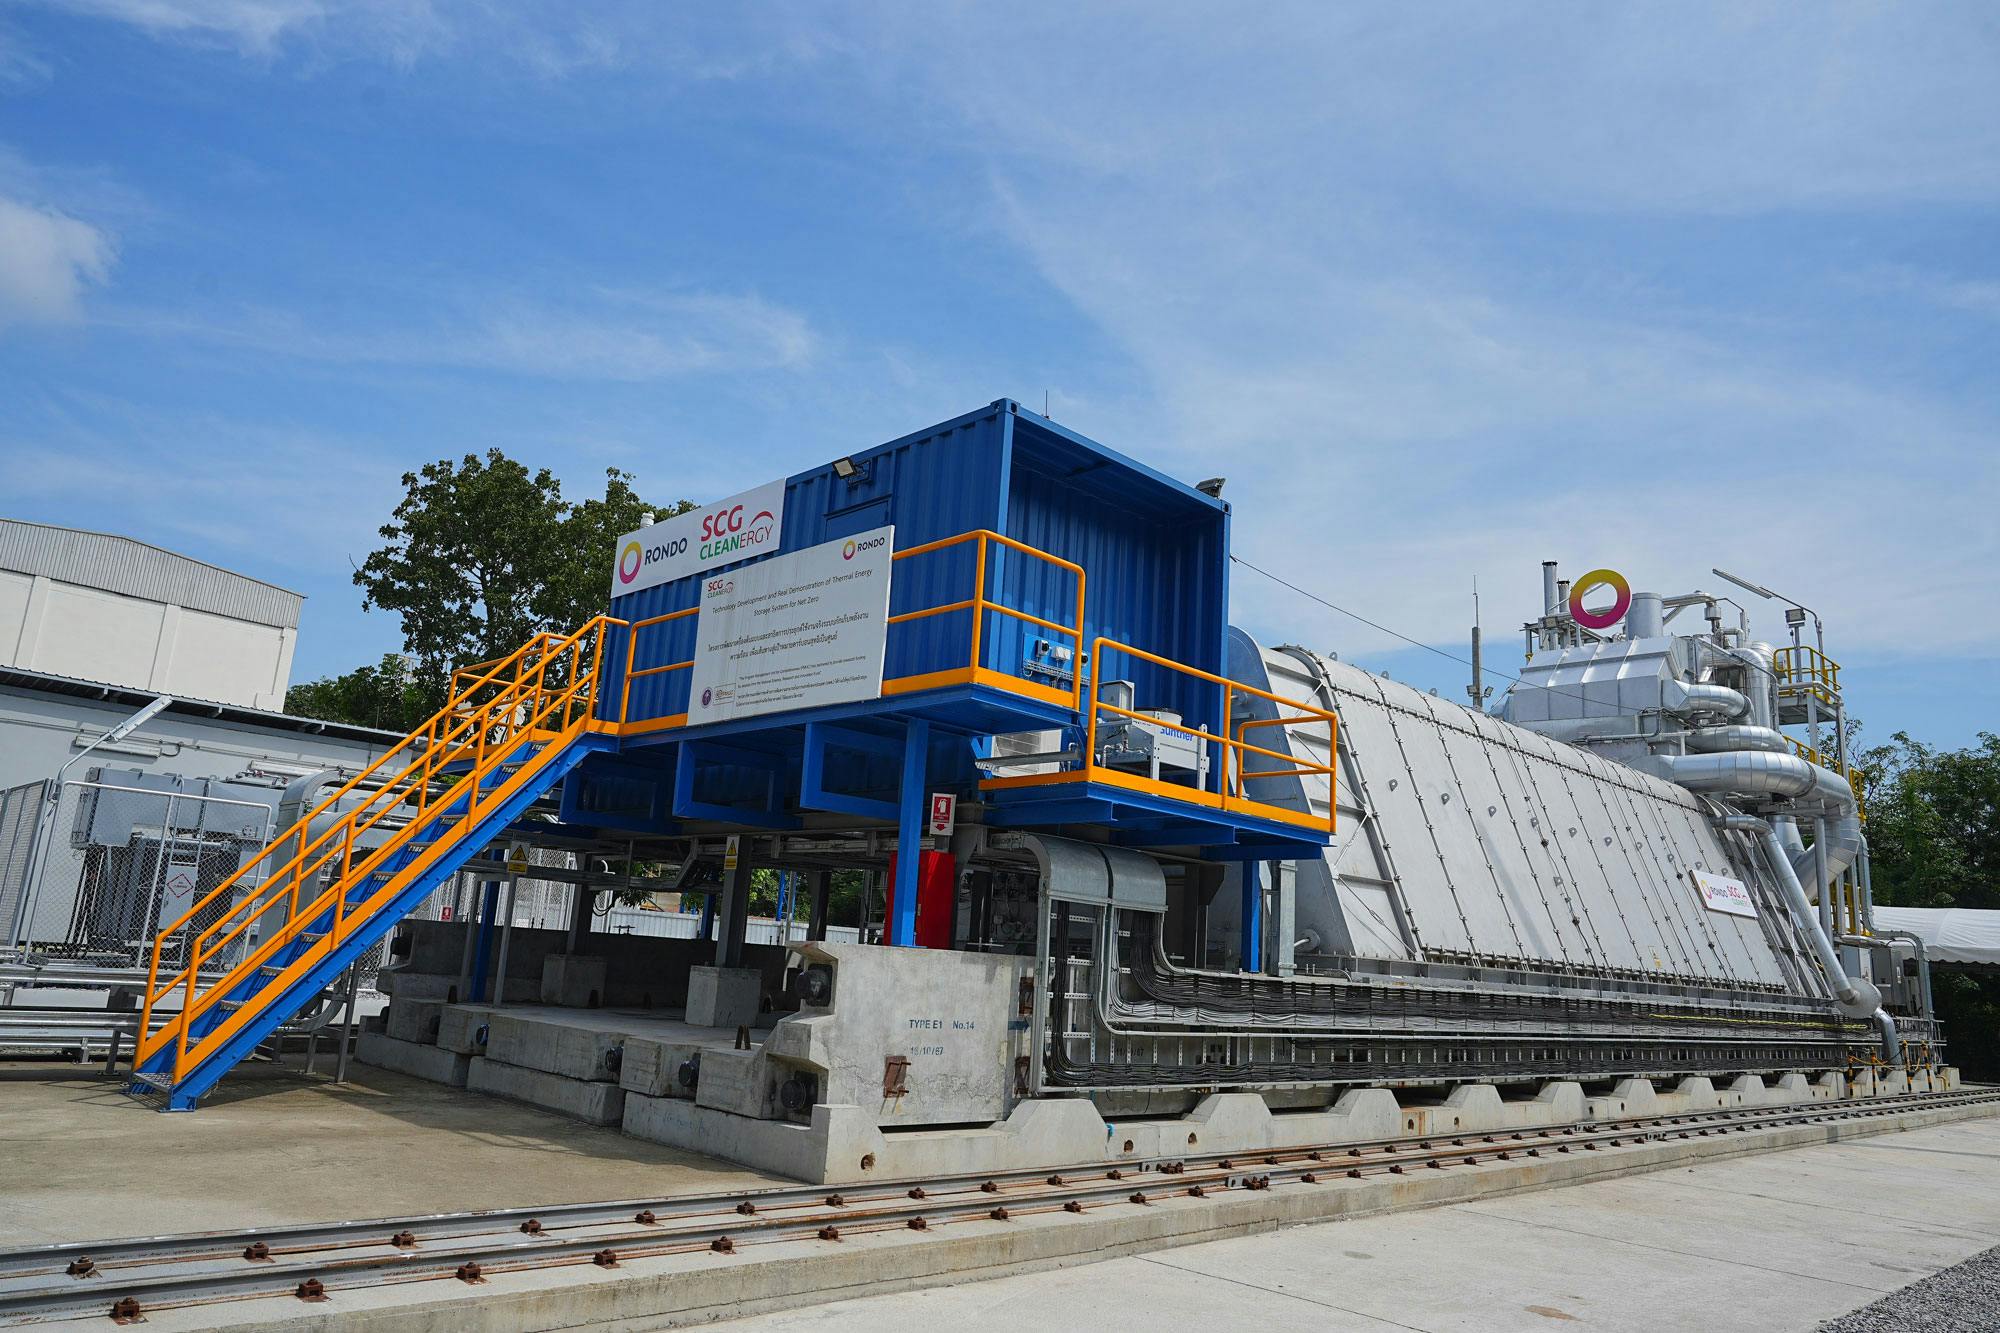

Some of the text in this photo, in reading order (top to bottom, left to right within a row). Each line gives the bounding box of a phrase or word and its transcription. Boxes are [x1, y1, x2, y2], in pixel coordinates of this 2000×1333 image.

[701, 505, 743, 542] SCG
[644, 537, 688, 566] RONDO
[700, 524, 773, 561] CLEANERGY
[857, 537, 885, 551] RONDO
[707, 579, 724, 592] SCG
[712, 568, 873, 614] Technology Development and Real Demonstration of Thermal Energy
[753, 596, 820, 617] Storage System for Net Zero
[909, 1019, 975, 1030] TYPE E1 No.14
